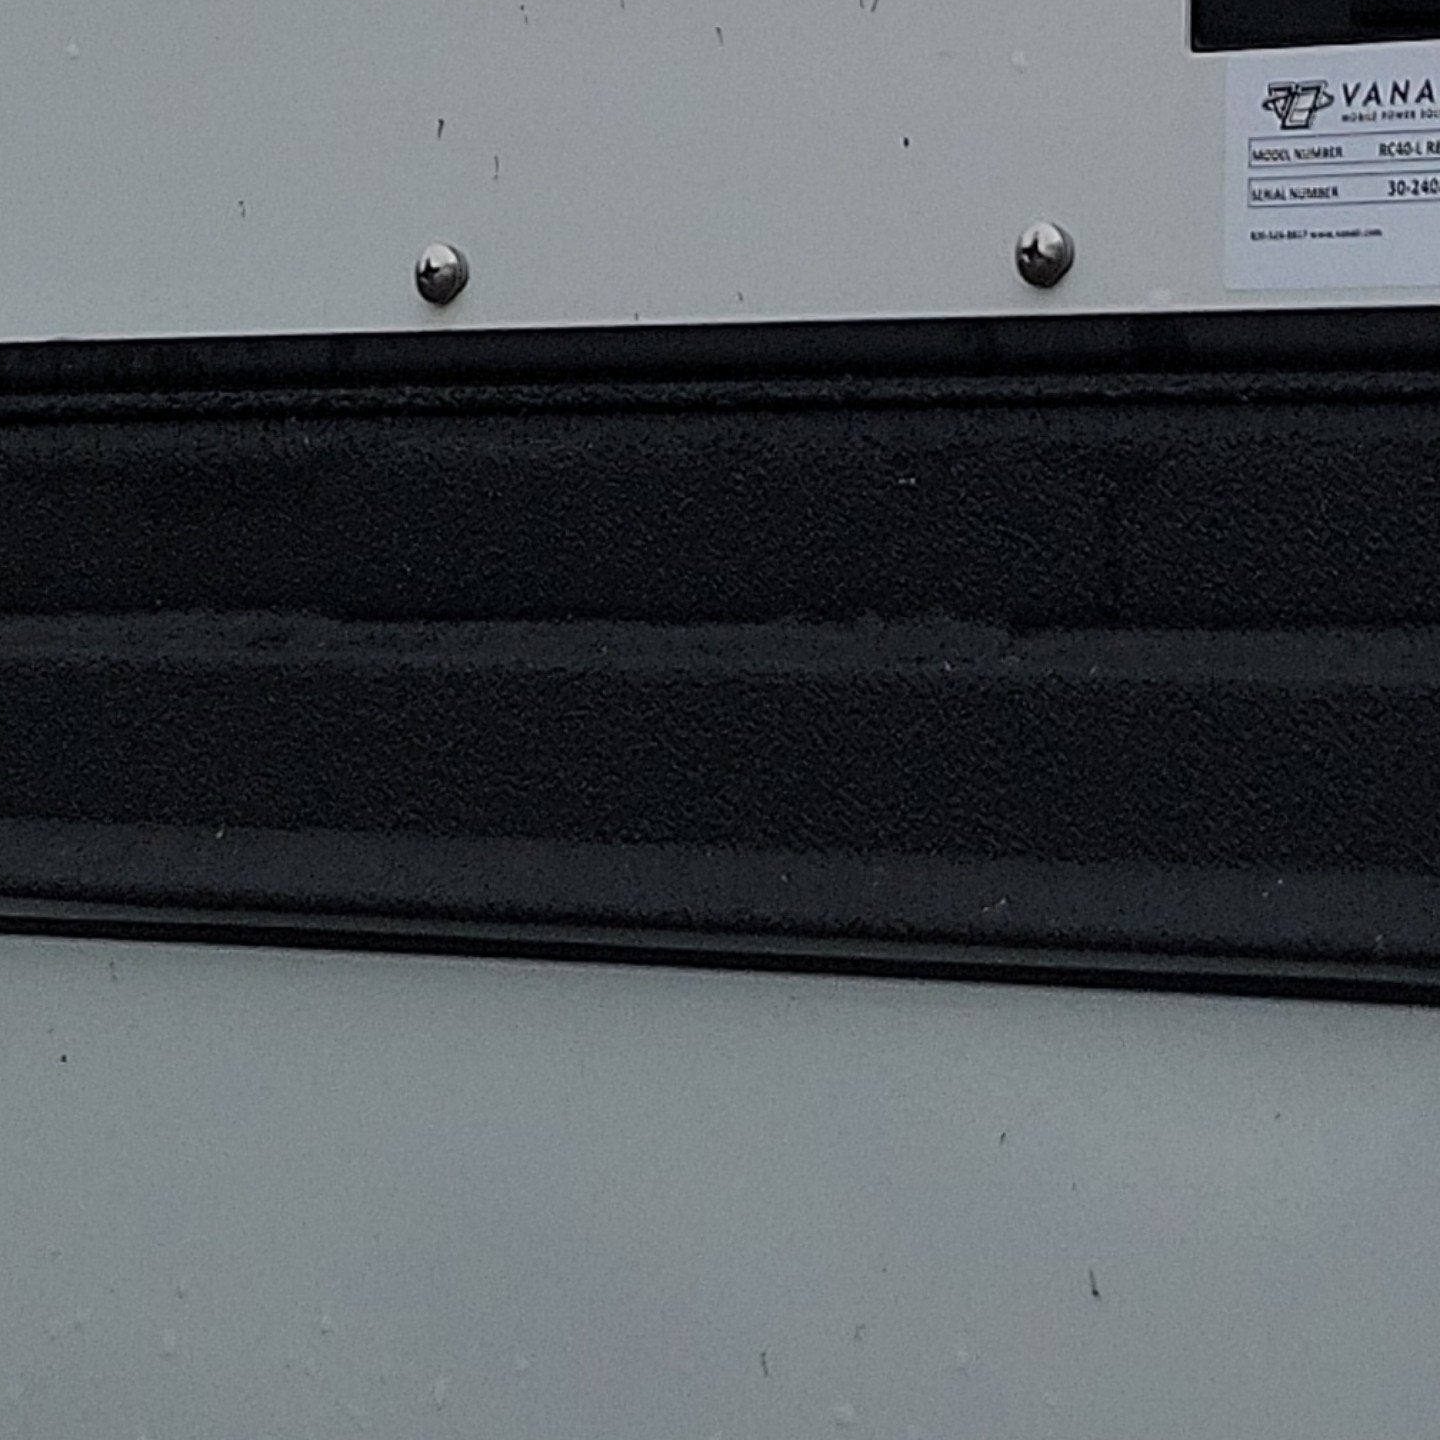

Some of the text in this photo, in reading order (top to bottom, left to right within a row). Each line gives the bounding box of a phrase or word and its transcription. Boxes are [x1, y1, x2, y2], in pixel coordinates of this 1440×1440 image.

[1293, 145, 1343, 160] NUMBER
[1252, 187, 1286, 202] SERIAL
[1289, 185, 1339, 200] NUMBER
